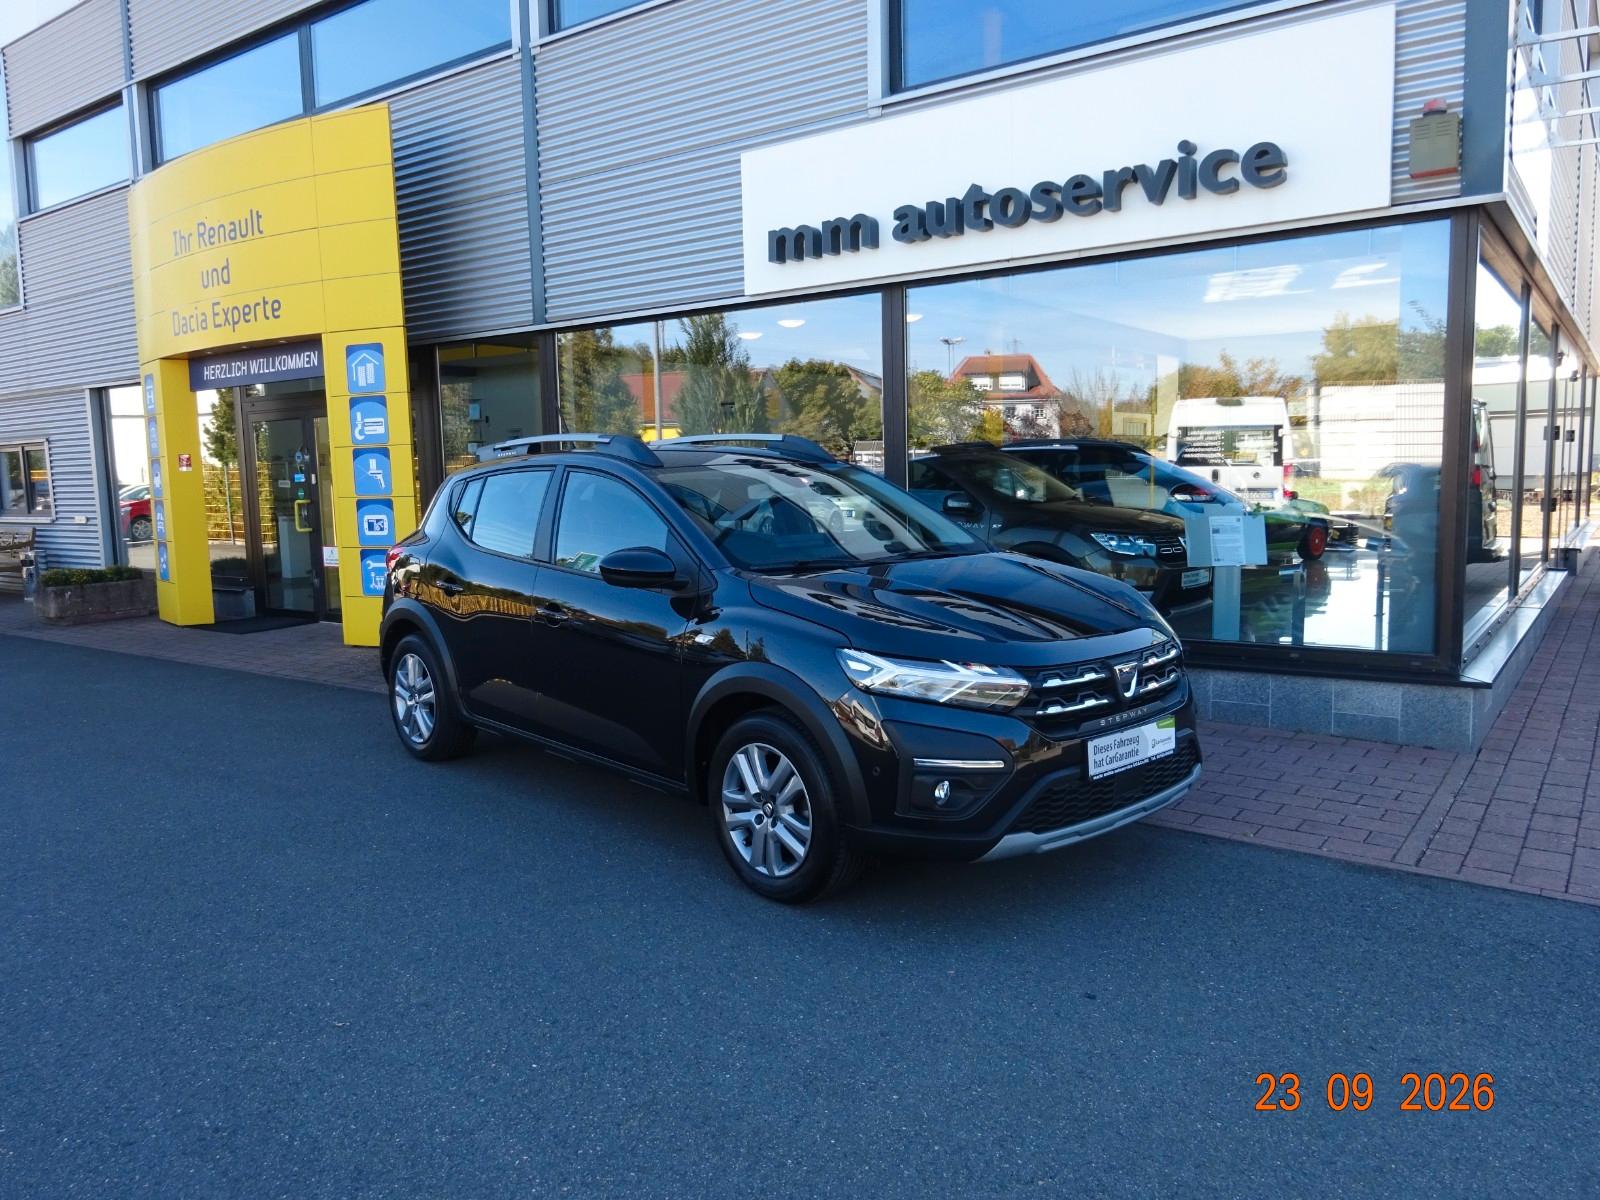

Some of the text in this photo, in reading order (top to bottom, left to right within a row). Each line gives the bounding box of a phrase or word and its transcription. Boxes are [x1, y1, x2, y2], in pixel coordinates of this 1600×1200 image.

[768, 139, 1288, 265] mm autoservice
[173, 208, 264, 256] Ihr Renault
[201, 257, 231, 289] und
[172, 295, 282, 336] Dacia Experte
[203, 350, 319, 380] HERZLICH WILLKOMMEN
[1100, 707, 1148, 726] STEPWAY
[1093, 743, 1113, 756] Dieses
[1113, 735, 1140, 750] Fahrzeug
[1093, 757, 1105, 769] hat
[1105, 746, 1140, 766] CarGarantie
